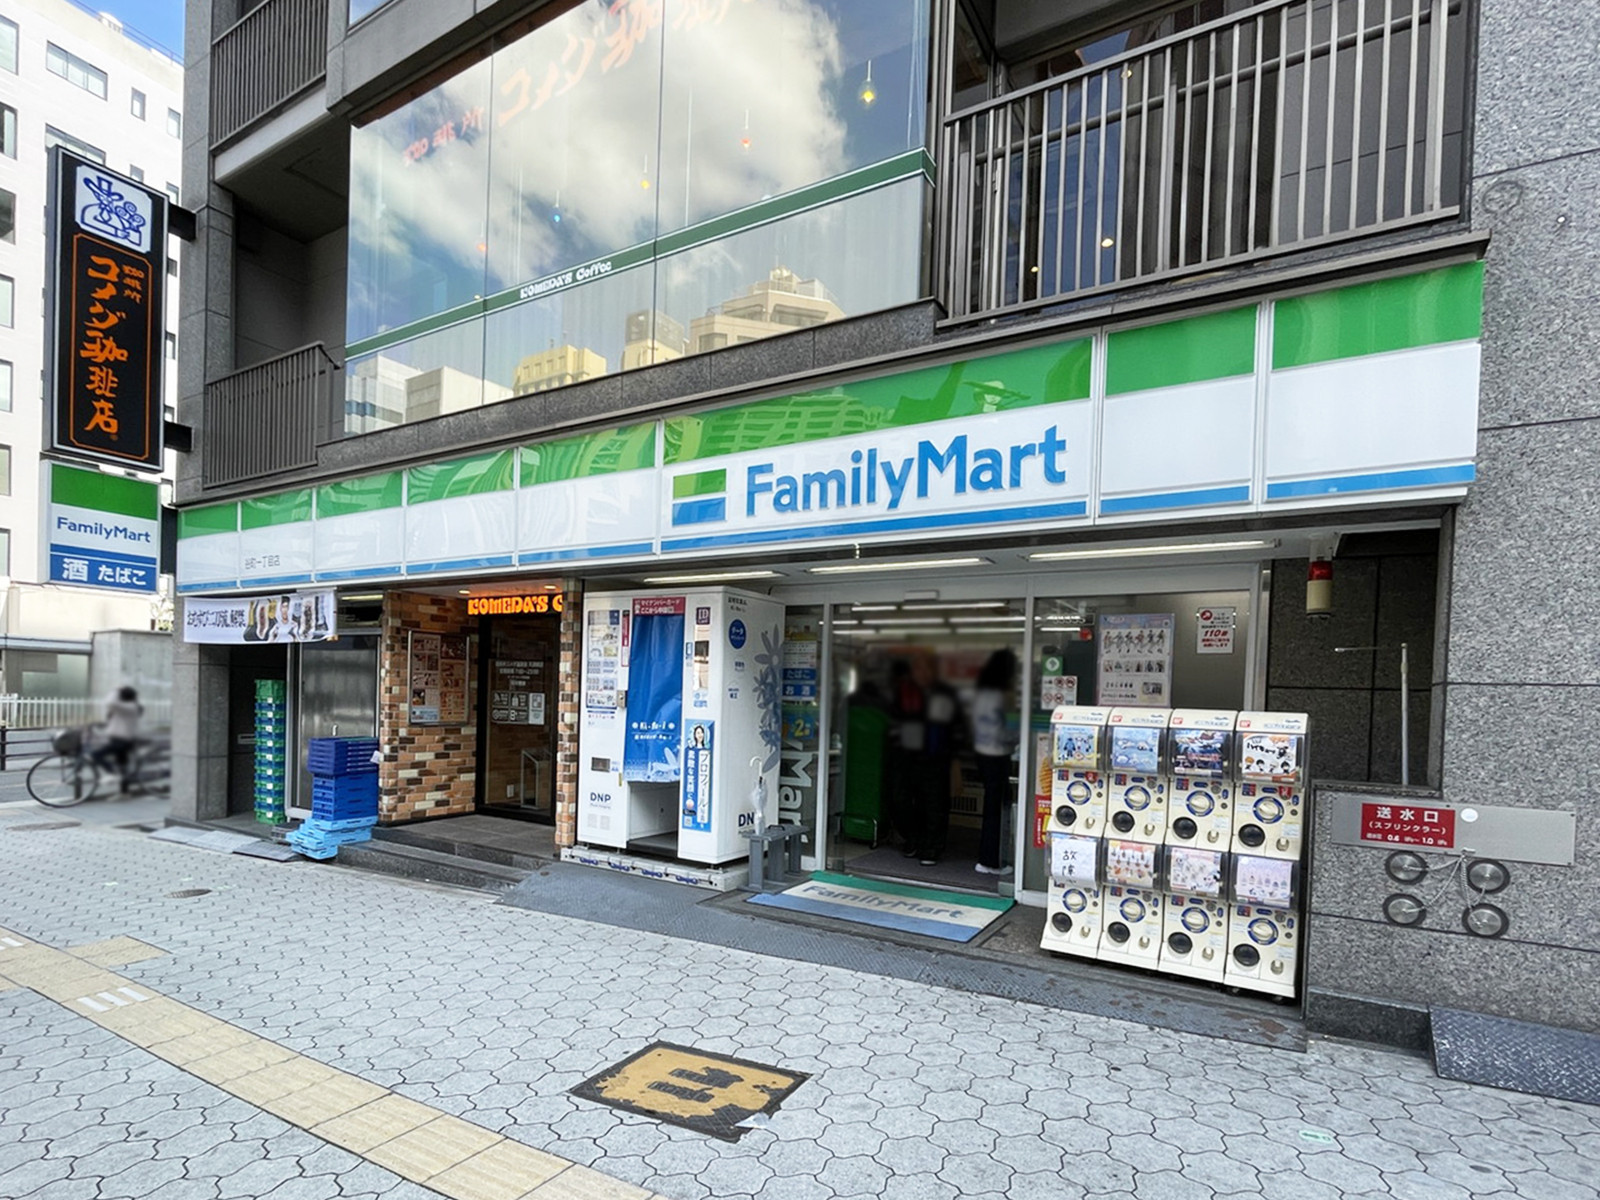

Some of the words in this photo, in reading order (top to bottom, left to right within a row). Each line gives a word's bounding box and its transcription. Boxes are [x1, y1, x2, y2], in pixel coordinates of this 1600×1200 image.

[746, 425, 1067, 518] FamilyMart
[57, 516, 151, 543] FamilyMart
[62, 558, 89, 582] 酒
[98, 565, 147, 585] たばこ
[468, 596, 549, 615] KOMEDA'S
[590, 792, 611, 803] DNP
[738, 811, 755, 827] DN
[1376, 806, 1439, 823] 送水口
[802, 885, 964, 919] FamilyMart
